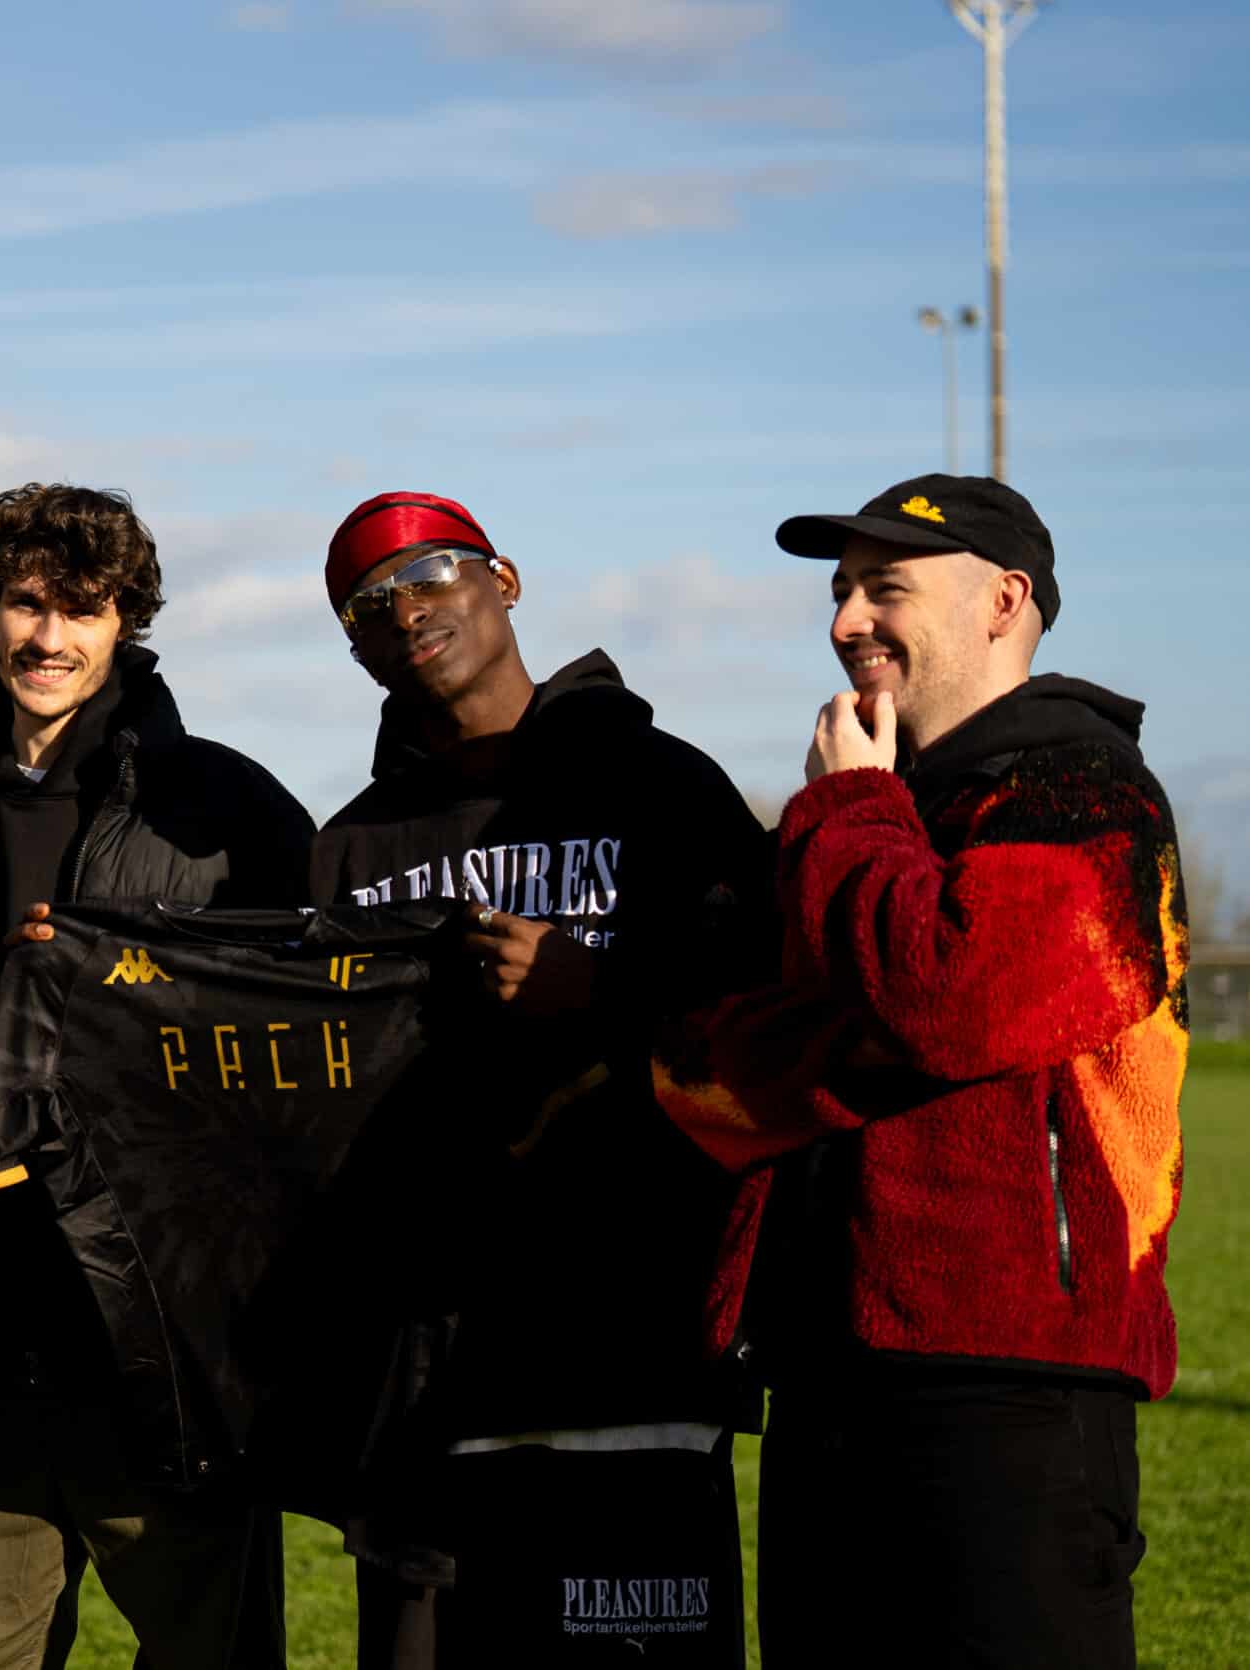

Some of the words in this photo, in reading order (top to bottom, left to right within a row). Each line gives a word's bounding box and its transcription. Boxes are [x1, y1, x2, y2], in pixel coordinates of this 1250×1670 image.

[160, 1020, 352, 1090] PACK
[562, 1577, 710, 1618] PLEASURES
[562, 1619, 709, 1636] Sportartikelhersteller
